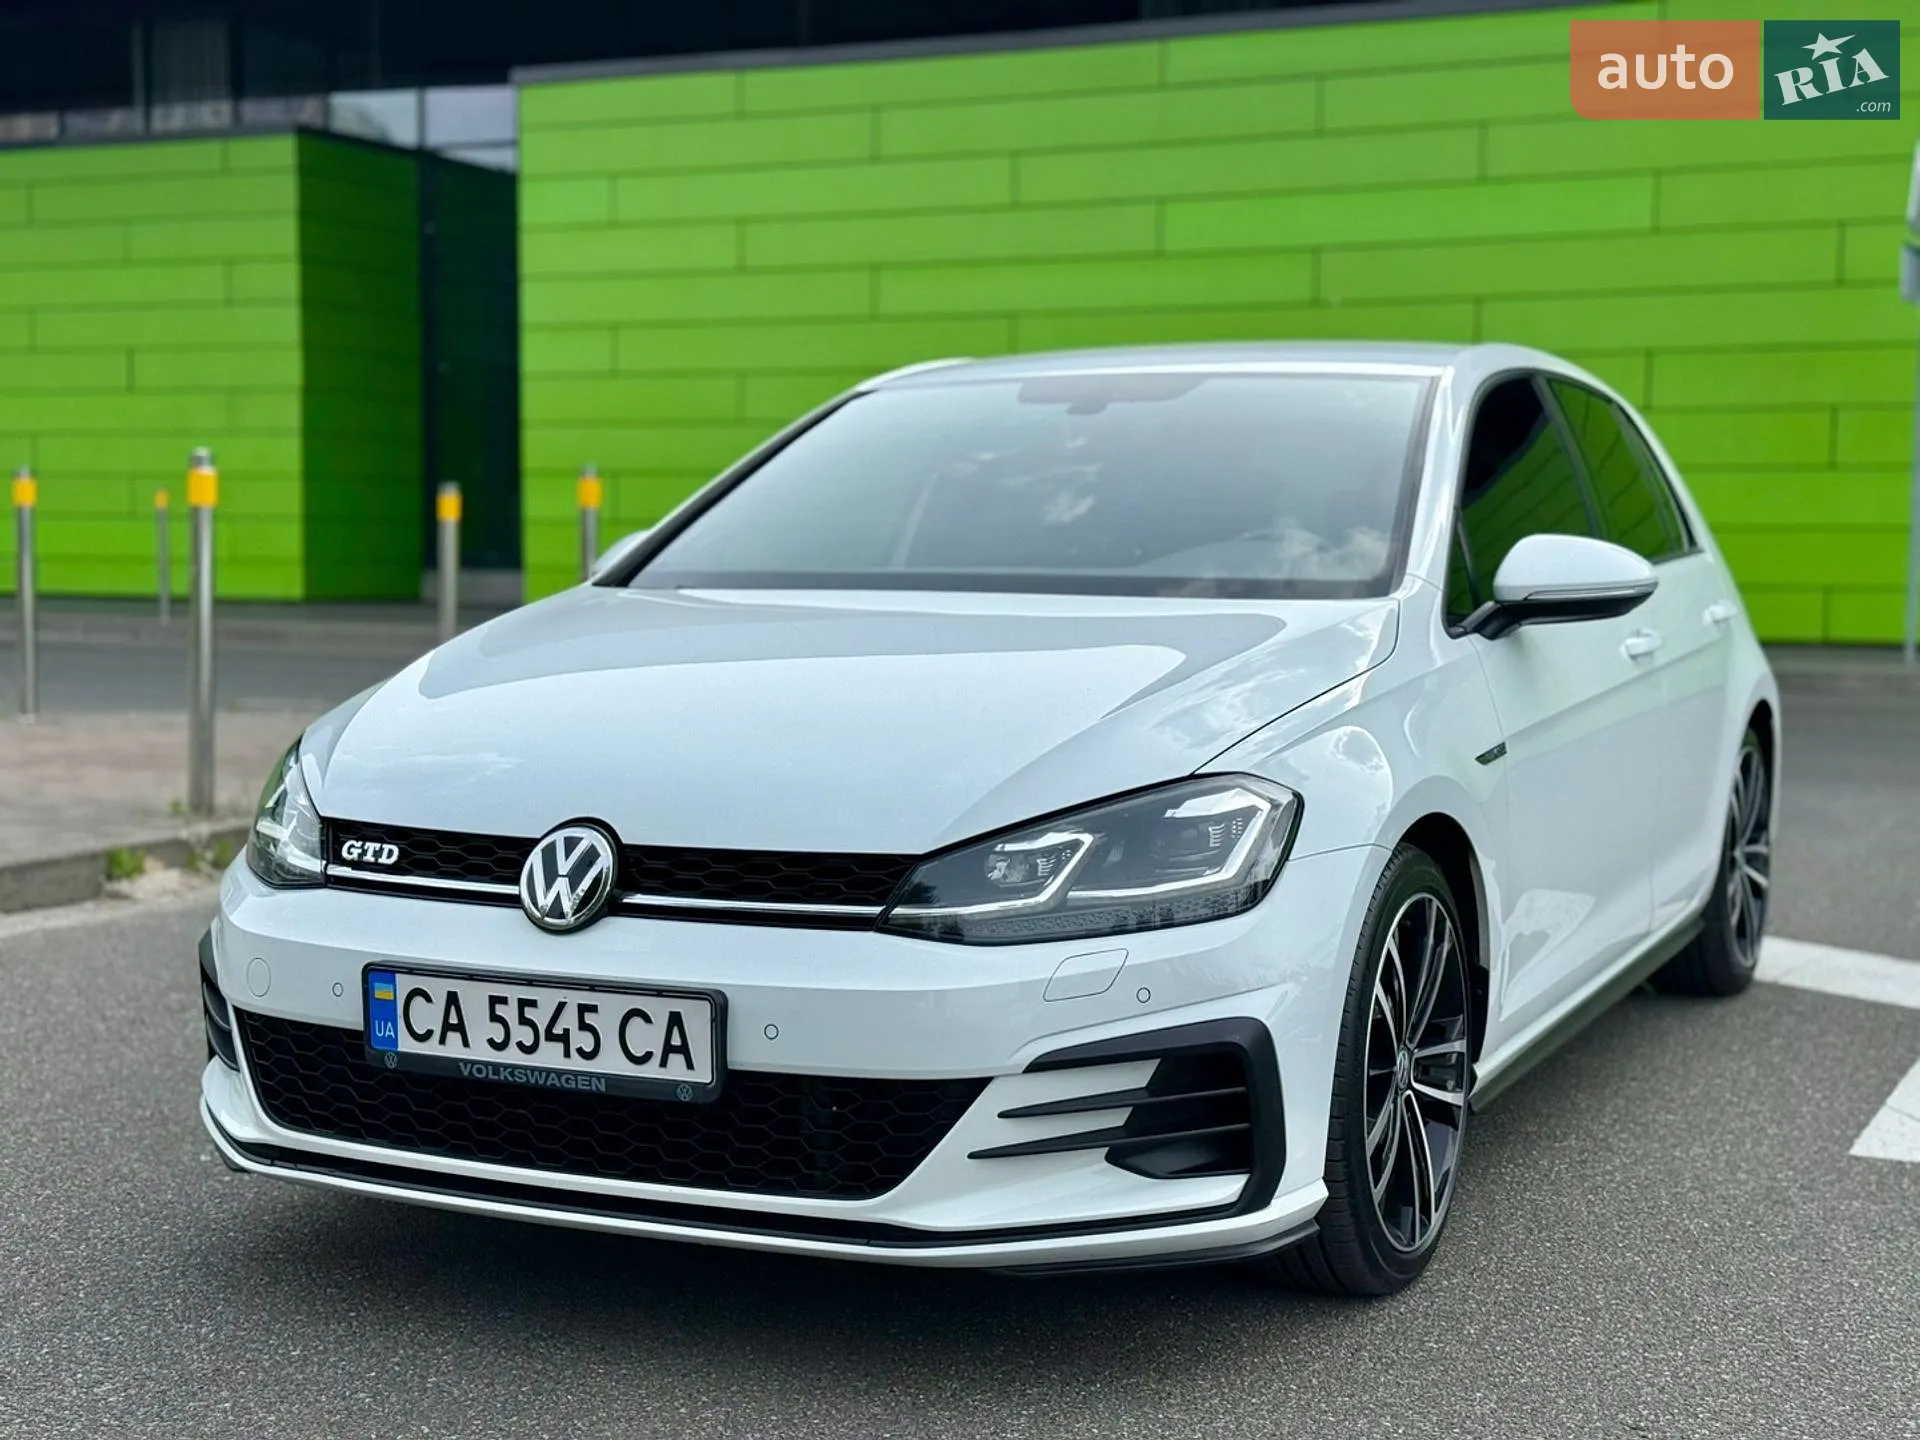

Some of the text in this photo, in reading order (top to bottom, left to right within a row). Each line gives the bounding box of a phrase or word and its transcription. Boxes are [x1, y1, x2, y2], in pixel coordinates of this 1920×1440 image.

[341, 839, 400, 866] GTD
[374, 1019, 396, 1040] UA
[402, 987, 696, 1072] CA 5545 CA
[458, 1062, 607, 1092] VOLKSWAGEN
